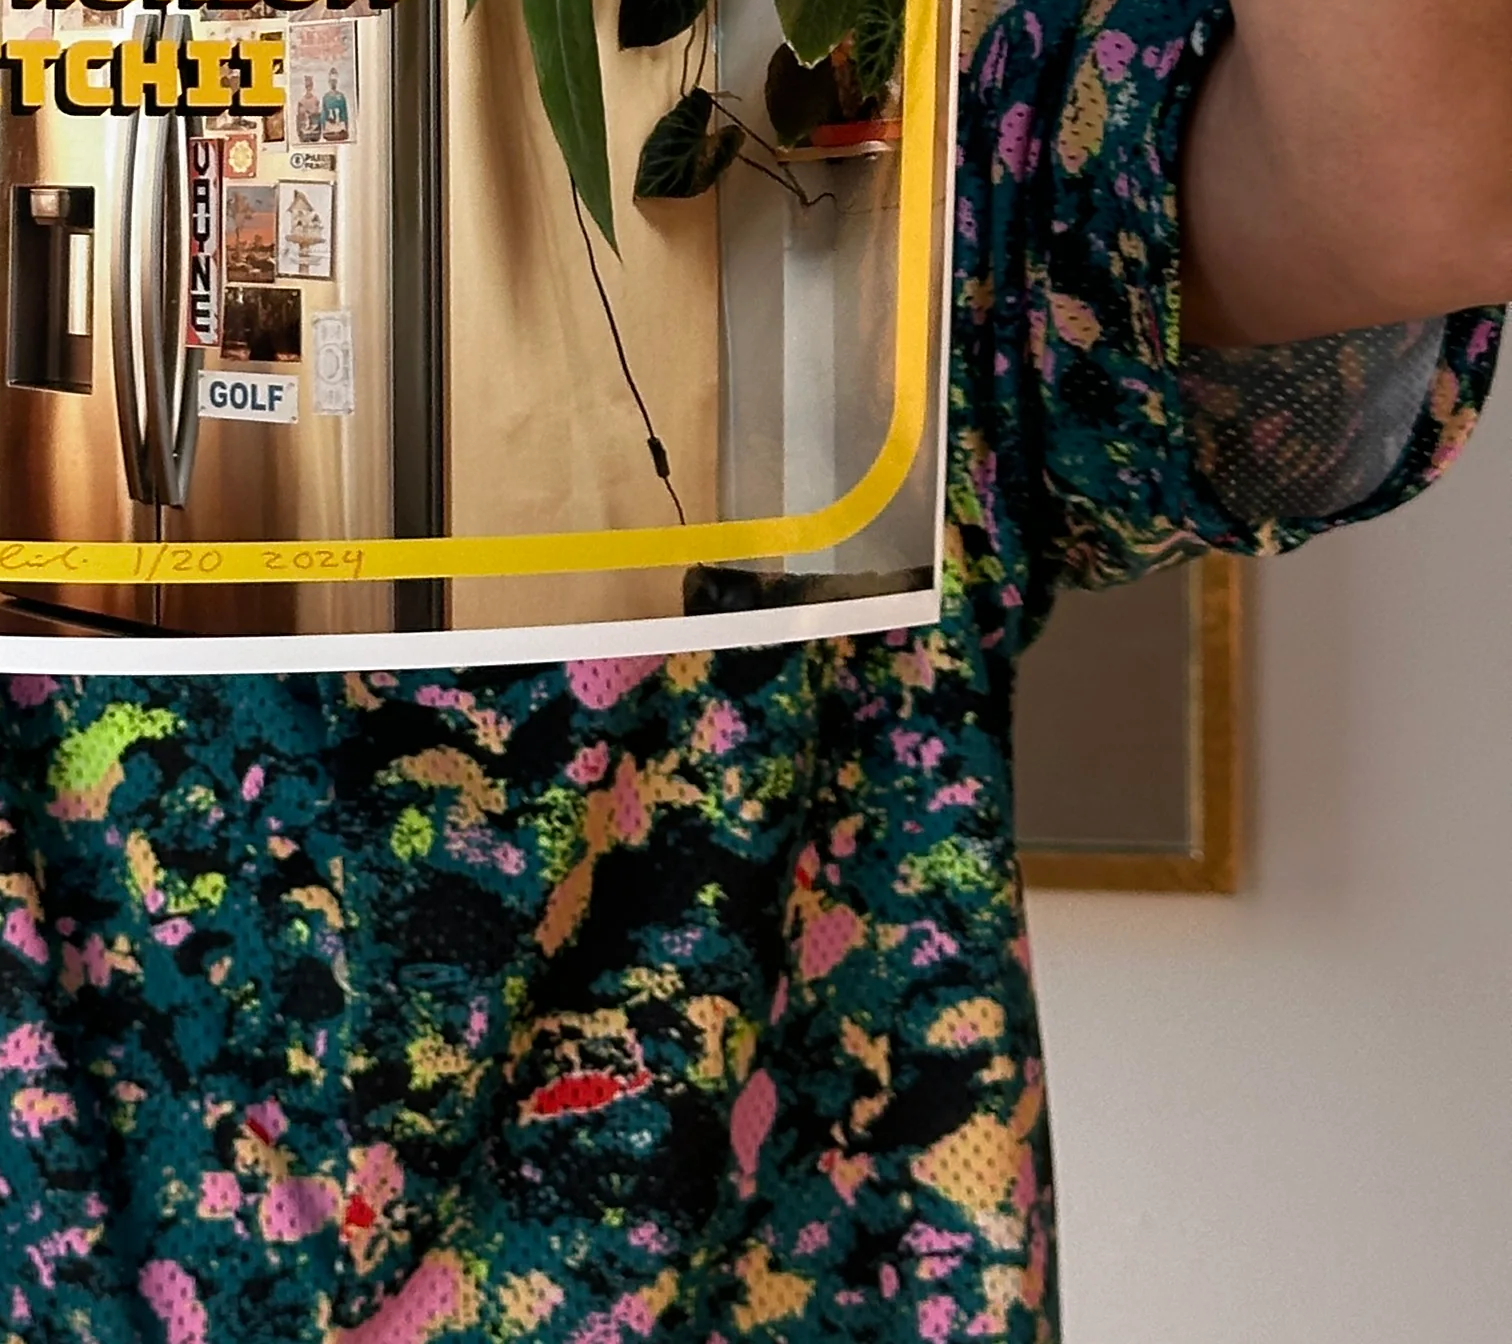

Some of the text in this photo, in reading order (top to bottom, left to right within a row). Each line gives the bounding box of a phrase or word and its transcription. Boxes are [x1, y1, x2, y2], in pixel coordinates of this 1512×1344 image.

[209, 380, 285, 413] GOLF
[134, 543, 367, 581] 1/20 2024
